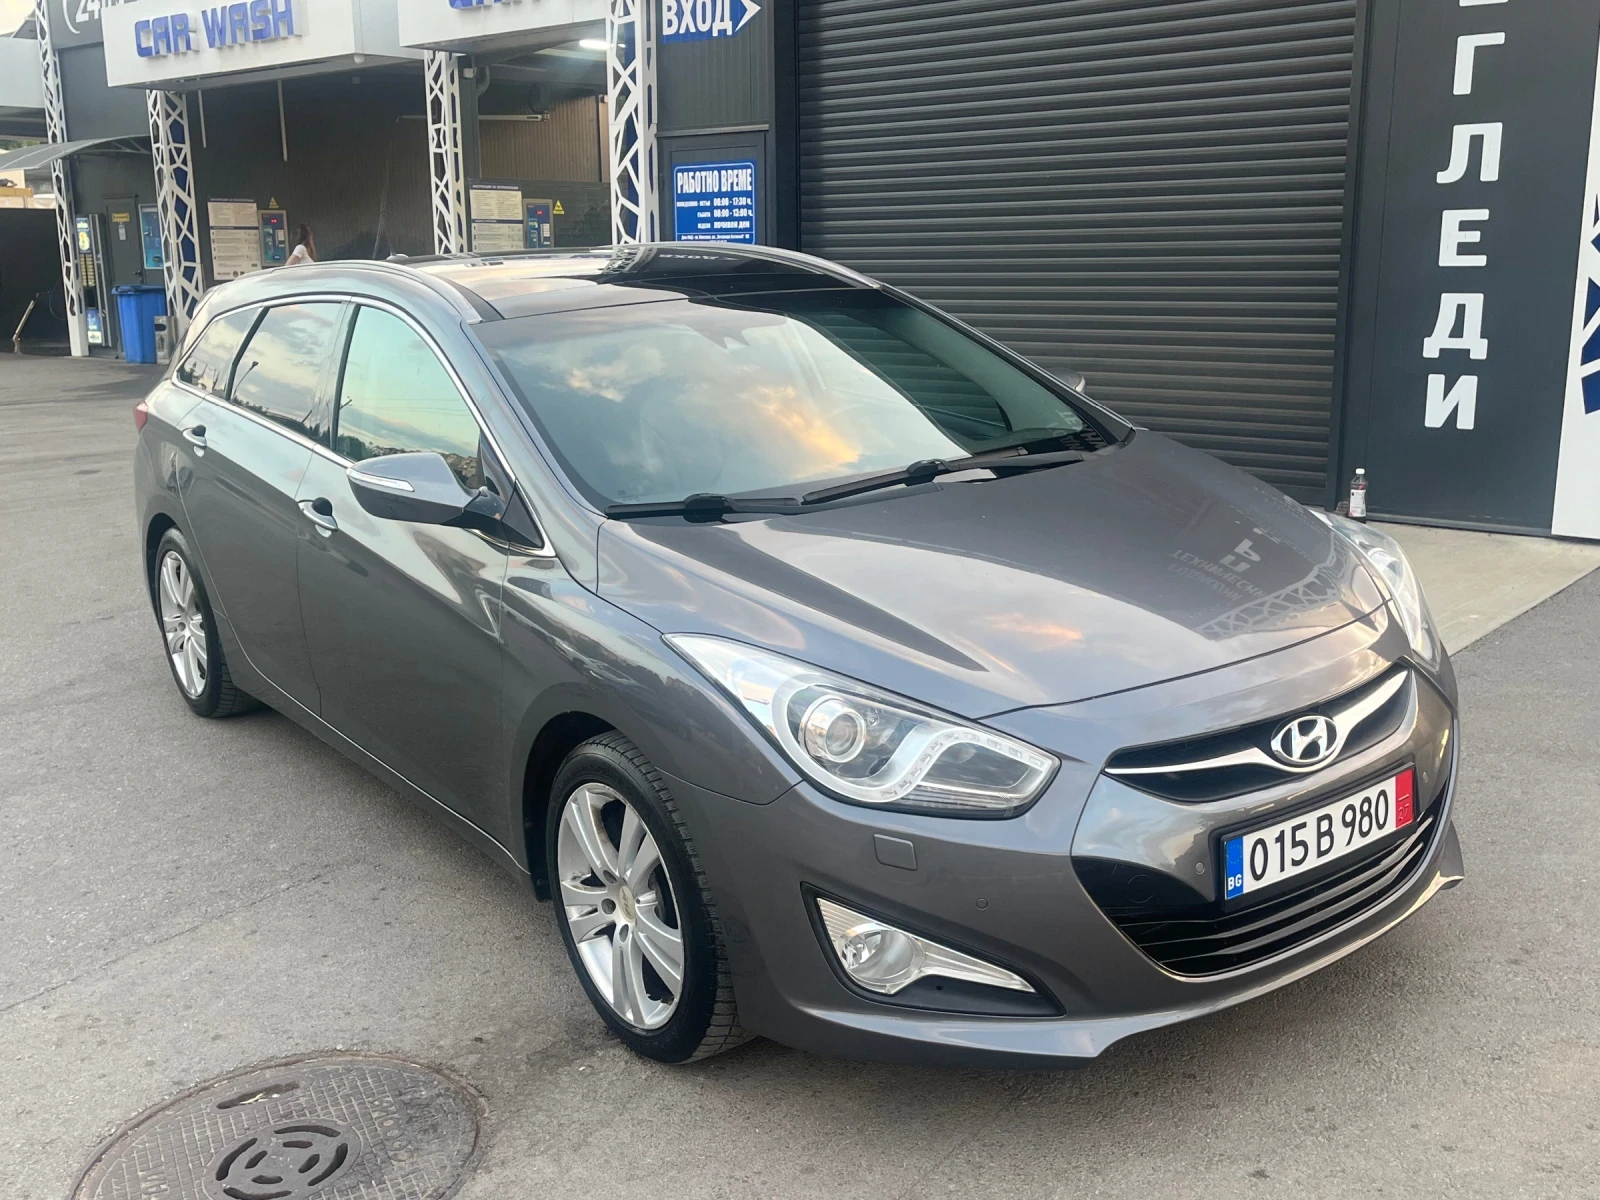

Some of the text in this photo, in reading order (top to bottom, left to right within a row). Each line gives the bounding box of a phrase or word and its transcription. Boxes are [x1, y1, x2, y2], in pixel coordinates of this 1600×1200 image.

[134, 0, 297, 58] CAR WASH
[662, 0, 732, 36] ВХОД
[677, 168, 752, 194] РАБОТНО ВРЕМЕ
[732, 197, 746, 205] 17:30
[1422, 0, 1507, 430] ГЛЕДИ
[1228, 874, 1242, 890] BG
